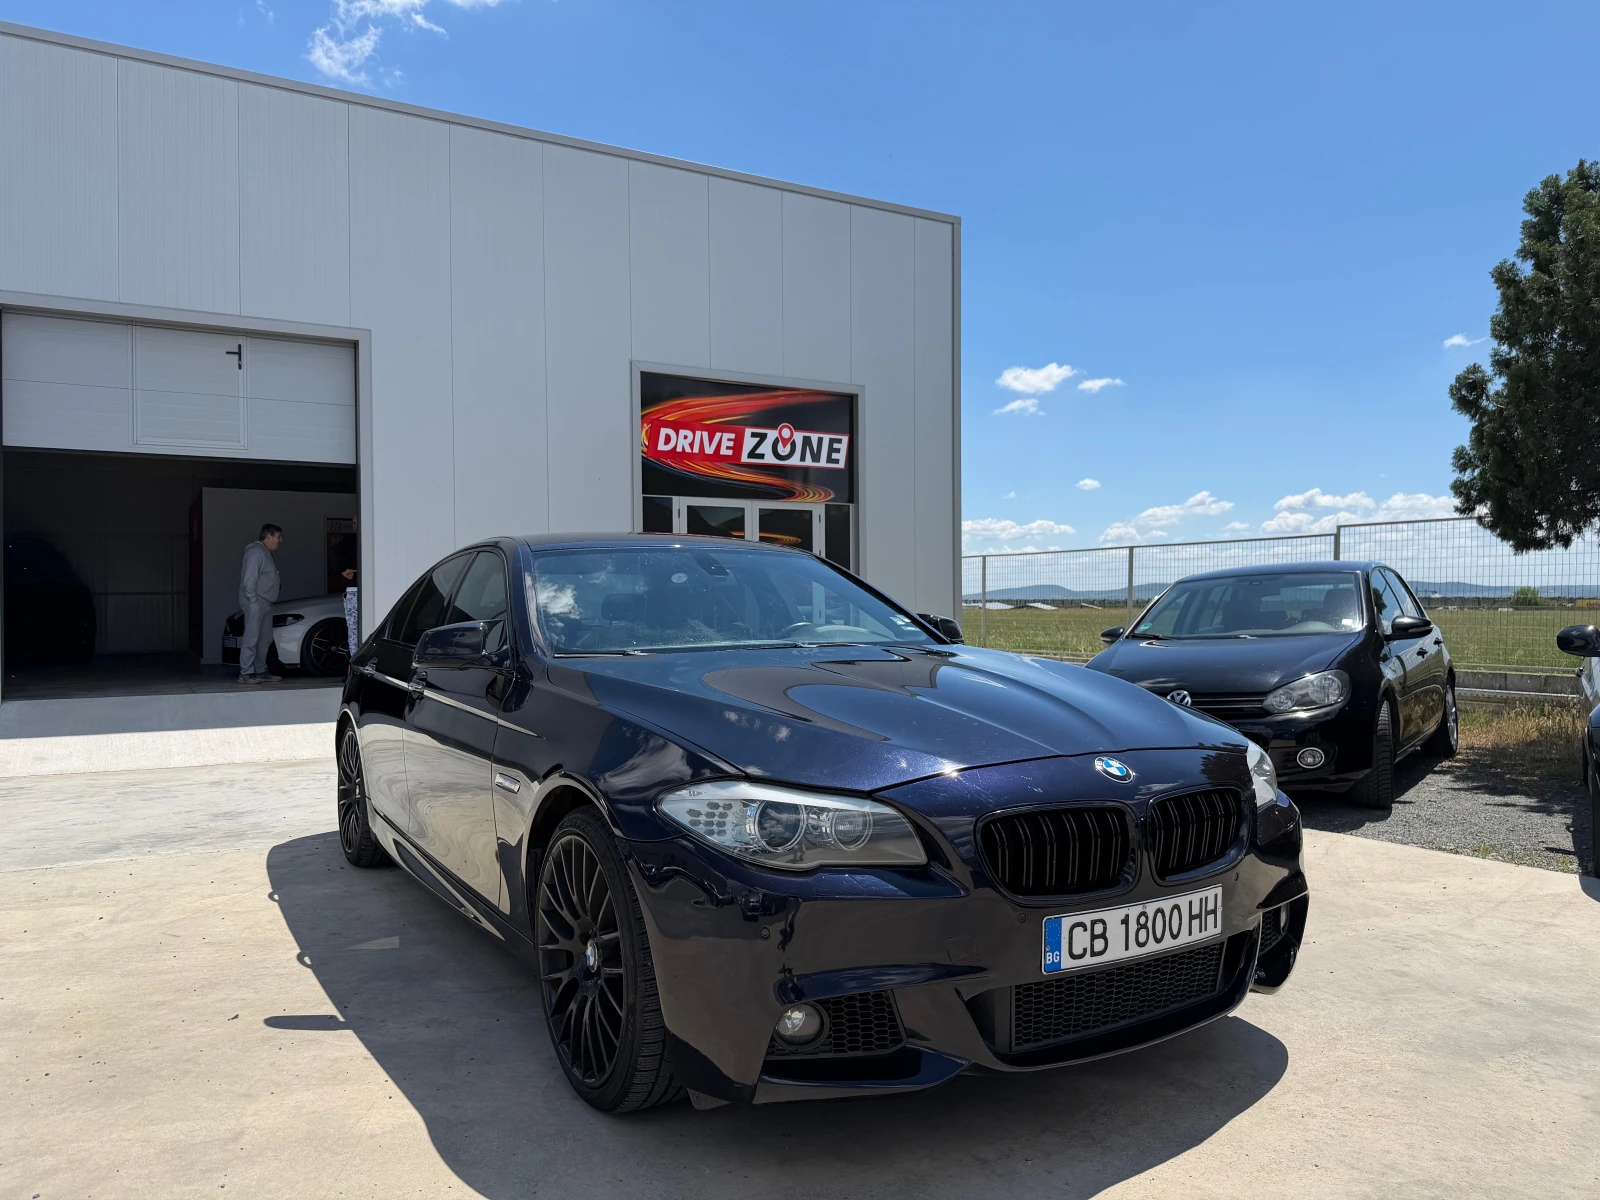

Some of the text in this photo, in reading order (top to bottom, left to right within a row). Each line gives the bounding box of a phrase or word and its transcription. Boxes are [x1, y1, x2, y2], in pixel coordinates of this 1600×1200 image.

[657, 427, 843, 465] DRIVE ZONE
[1067, 893, 1218, 961] CB 1800 HH
[1045, 951, 1060, 965] BG
